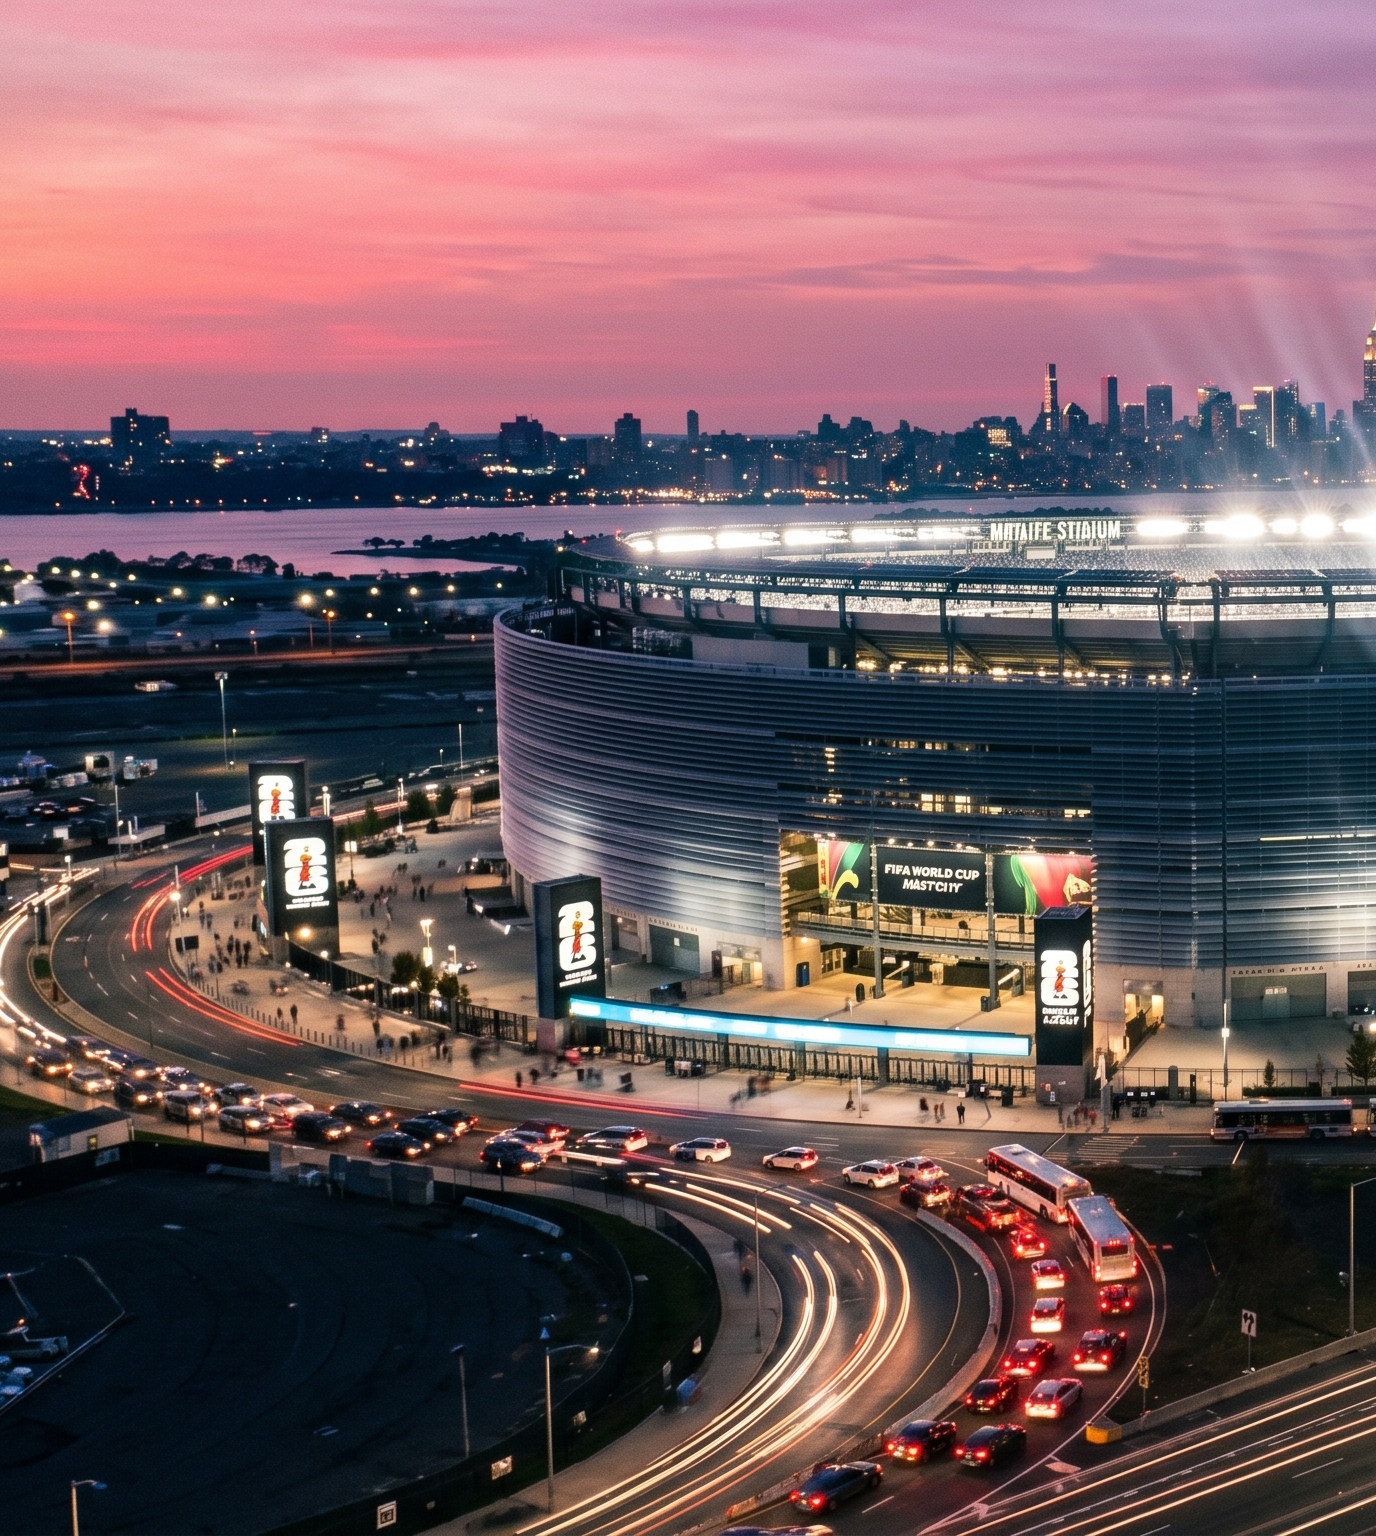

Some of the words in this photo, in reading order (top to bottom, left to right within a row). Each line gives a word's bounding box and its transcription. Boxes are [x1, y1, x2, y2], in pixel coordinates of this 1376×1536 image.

[884, 863, 910, 875] FIFA
[911, 866, 953, 879] WORLD
[955, 868, 980, 880] CUP
